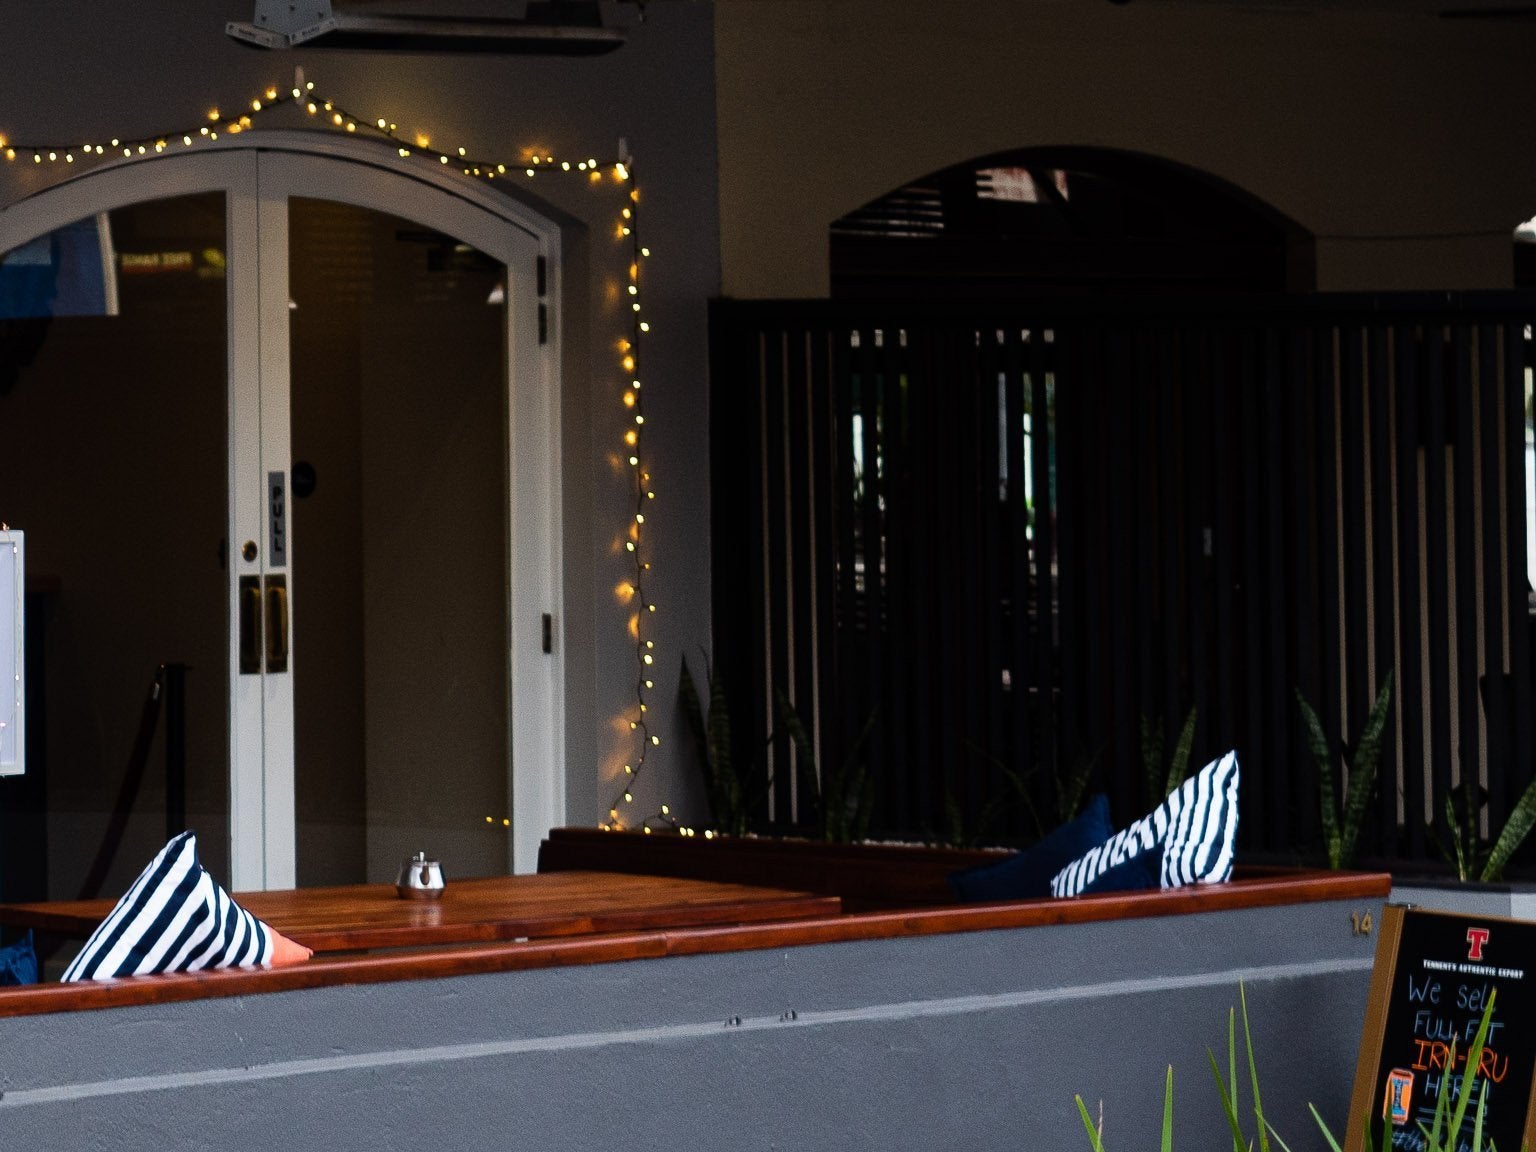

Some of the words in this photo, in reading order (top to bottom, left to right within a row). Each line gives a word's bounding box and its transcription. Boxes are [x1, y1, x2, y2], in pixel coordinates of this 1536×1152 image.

[272, 485, 283, 553] PULL
[1351, 910, 1373, 936] 14
[1466, 927, 1489, 961] T
[1409, 974, 1441, 1004] We
[1414, 1010, 1460, 1040] FULL
[1465, 1019, 1505, 1046] FT
[1411, 1039, 1509, 1083] IRN-RU
